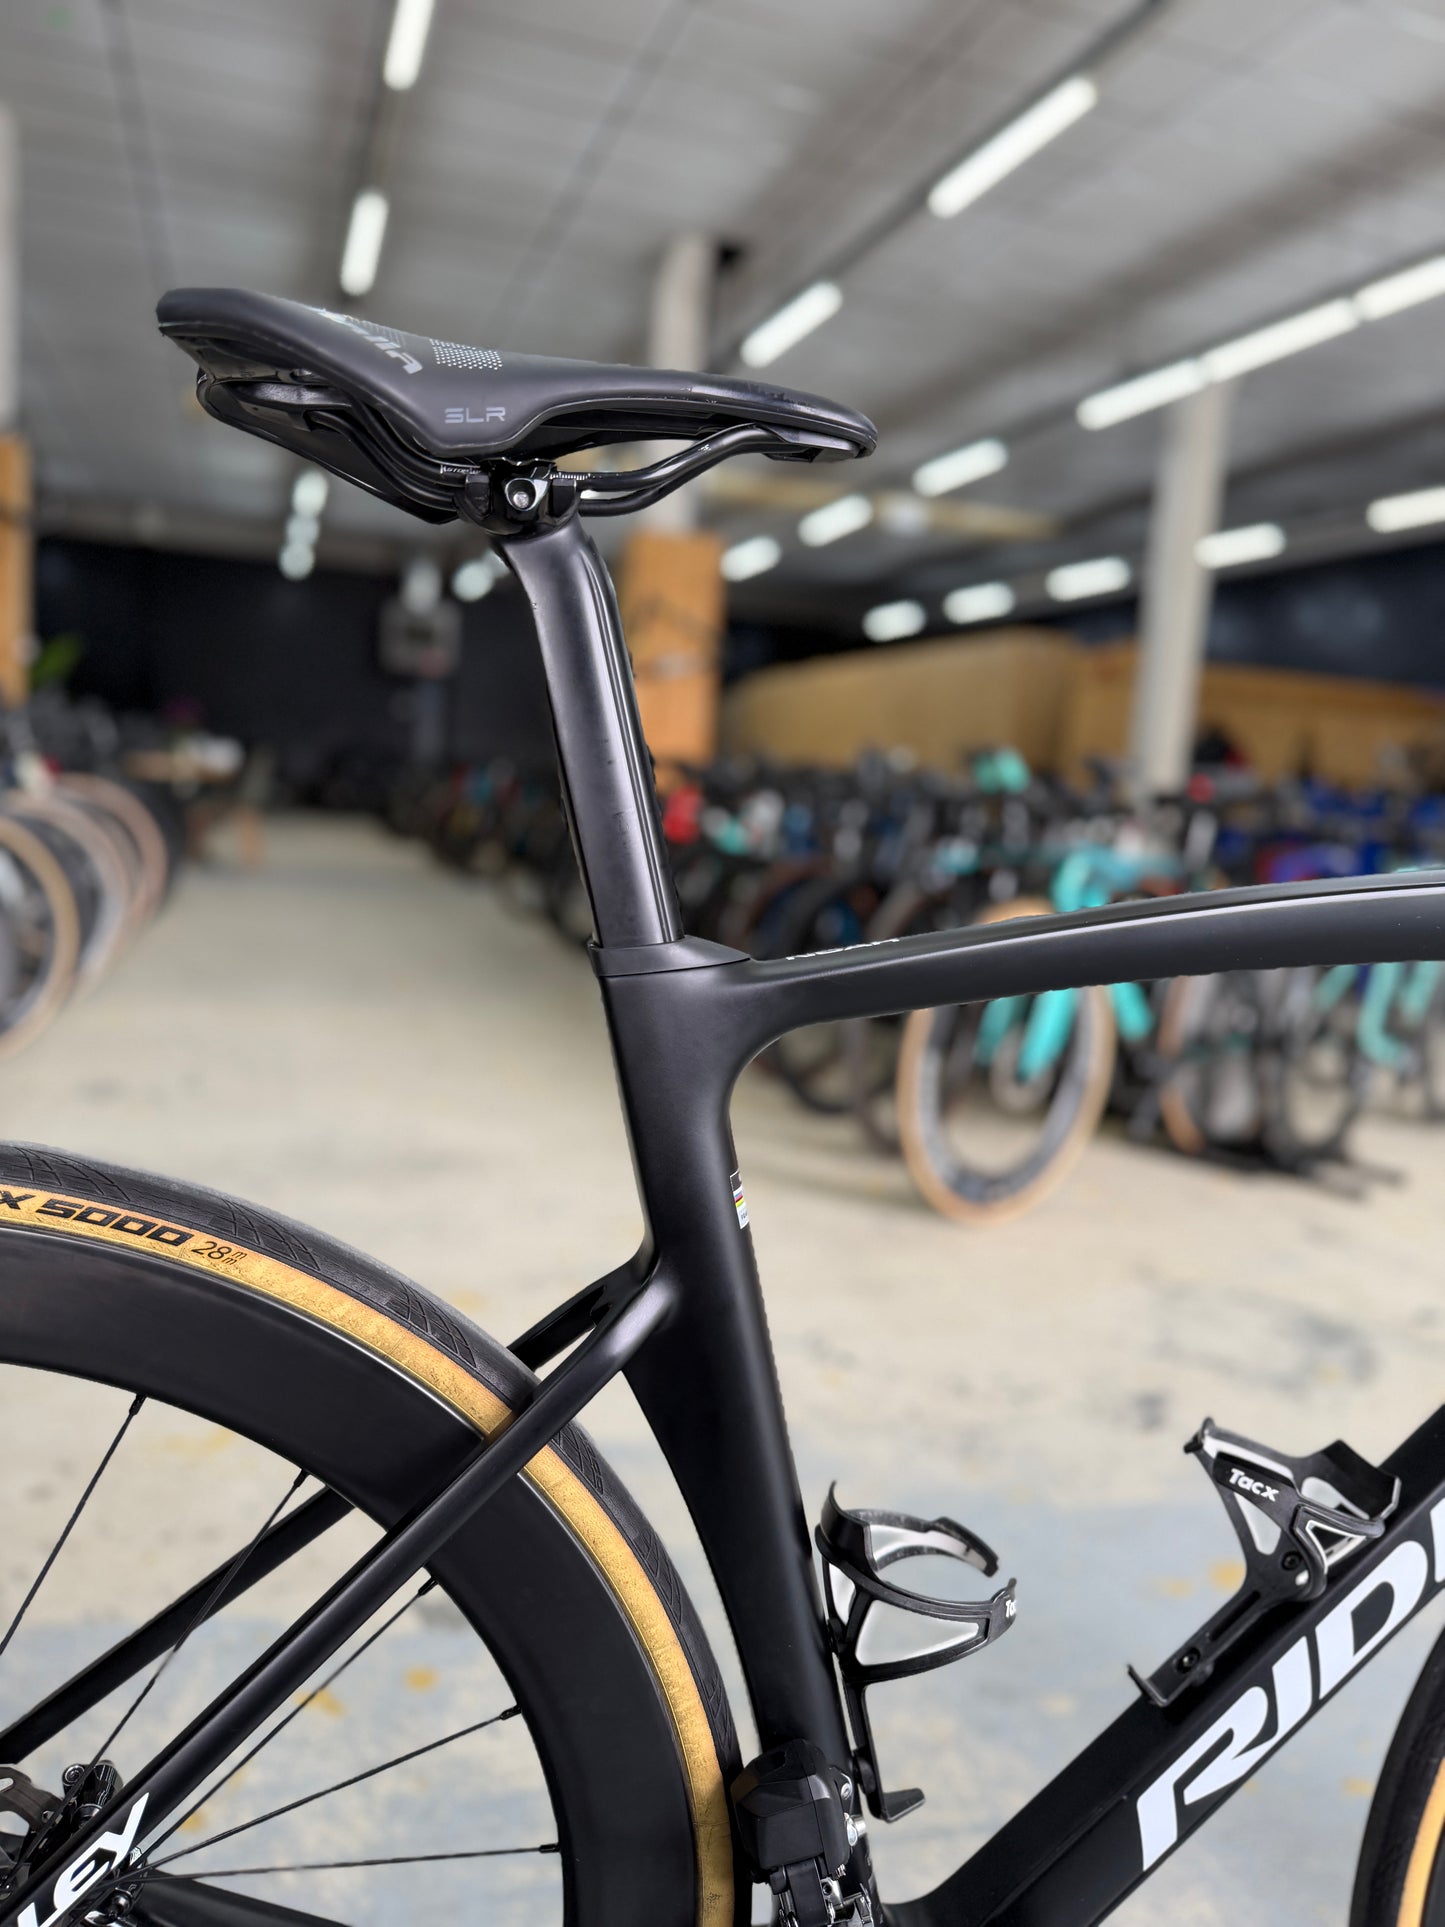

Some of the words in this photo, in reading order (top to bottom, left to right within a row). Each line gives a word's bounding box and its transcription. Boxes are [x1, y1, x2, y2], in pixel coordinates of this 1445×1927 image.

[444, 406, 506, 424] SLR
[35, 1198, 195, 1247] 5000
[1229, 1467, 1280, 1502] Tacx
[1136, 1496, 1445, 1873] RID
